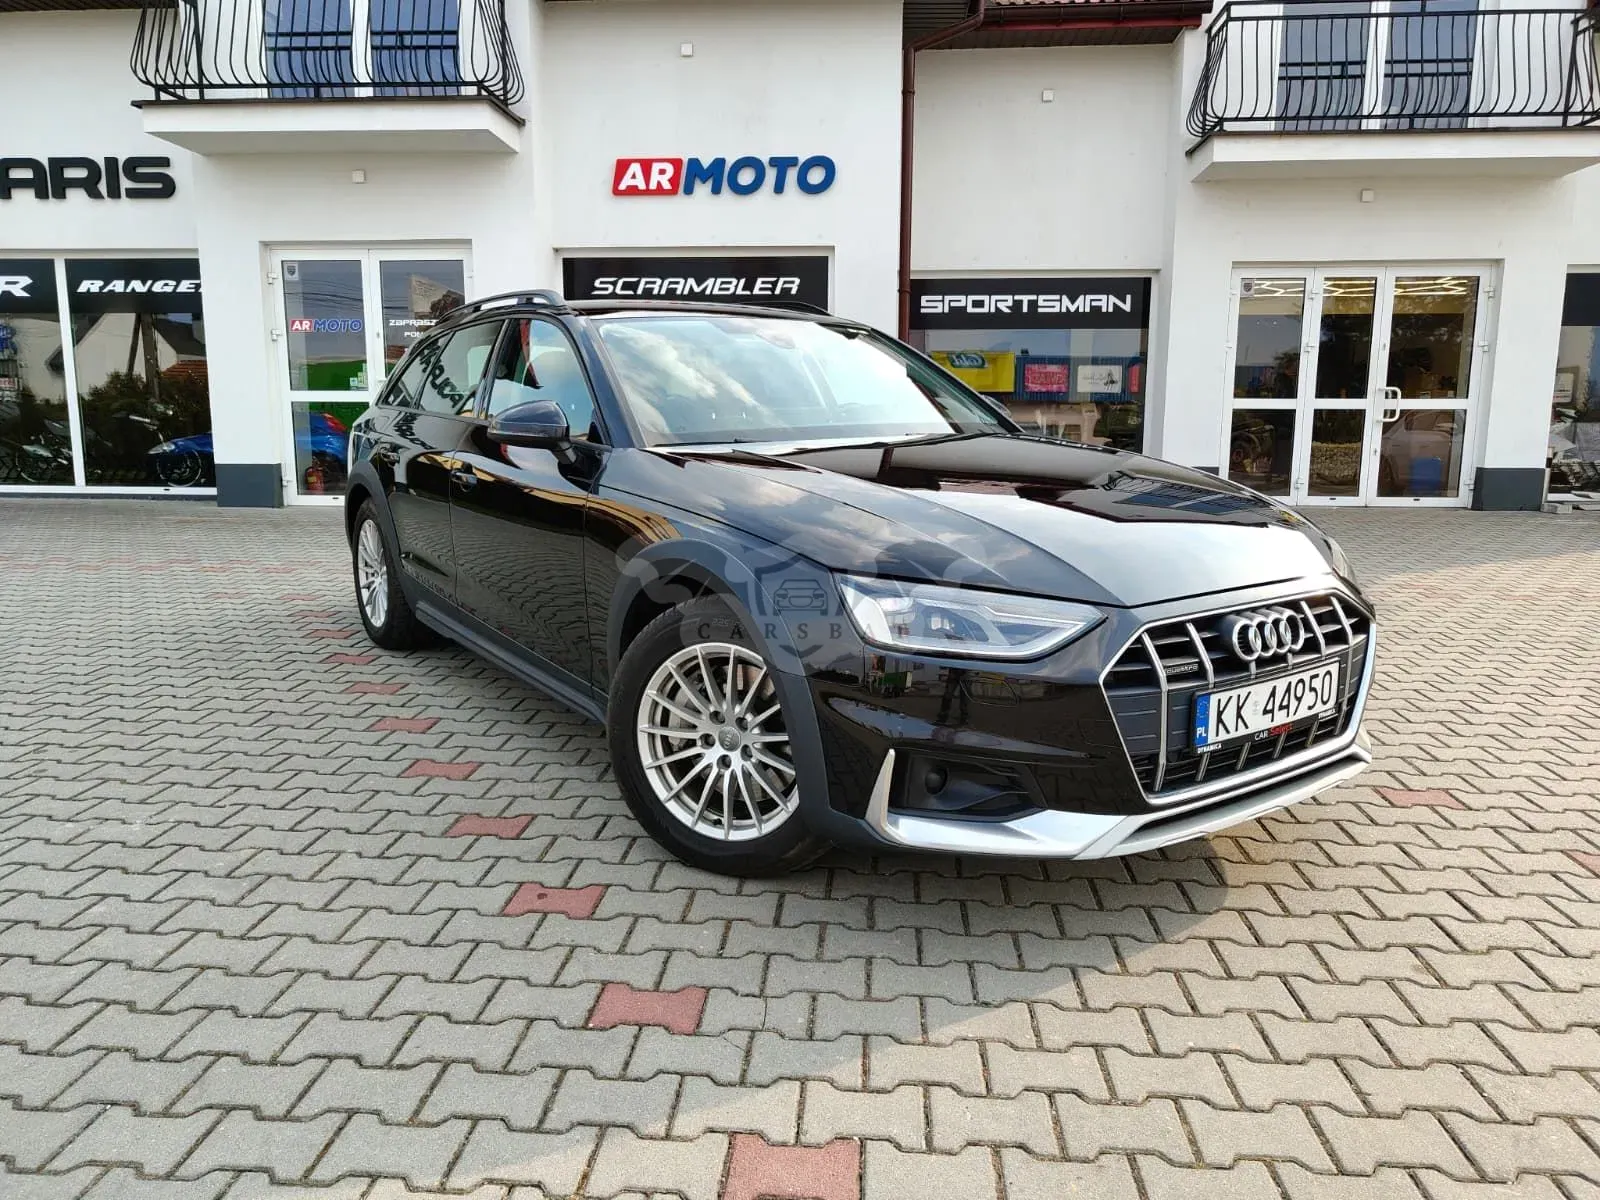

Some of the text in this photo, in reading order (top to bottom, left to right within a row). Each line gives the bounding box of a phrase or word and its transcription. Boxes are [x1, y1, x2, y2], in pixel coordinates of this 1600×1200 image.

[0, 156, 176, 200] ARIS
[616, 155, 836, 195] ARMOTO
[77, 279, 201, 293] RANGE
[591, 277, 800, 295] SCRAMBLER
[920, 294, 1131, 313] SPORTSMAN
[291, 318, 363, 333] ARMOTO
[1216, 670, 1333, 737] KK 44950
[1196, 728, 1207, 739] PL
[1254, 732, 1268, 741] CAR
